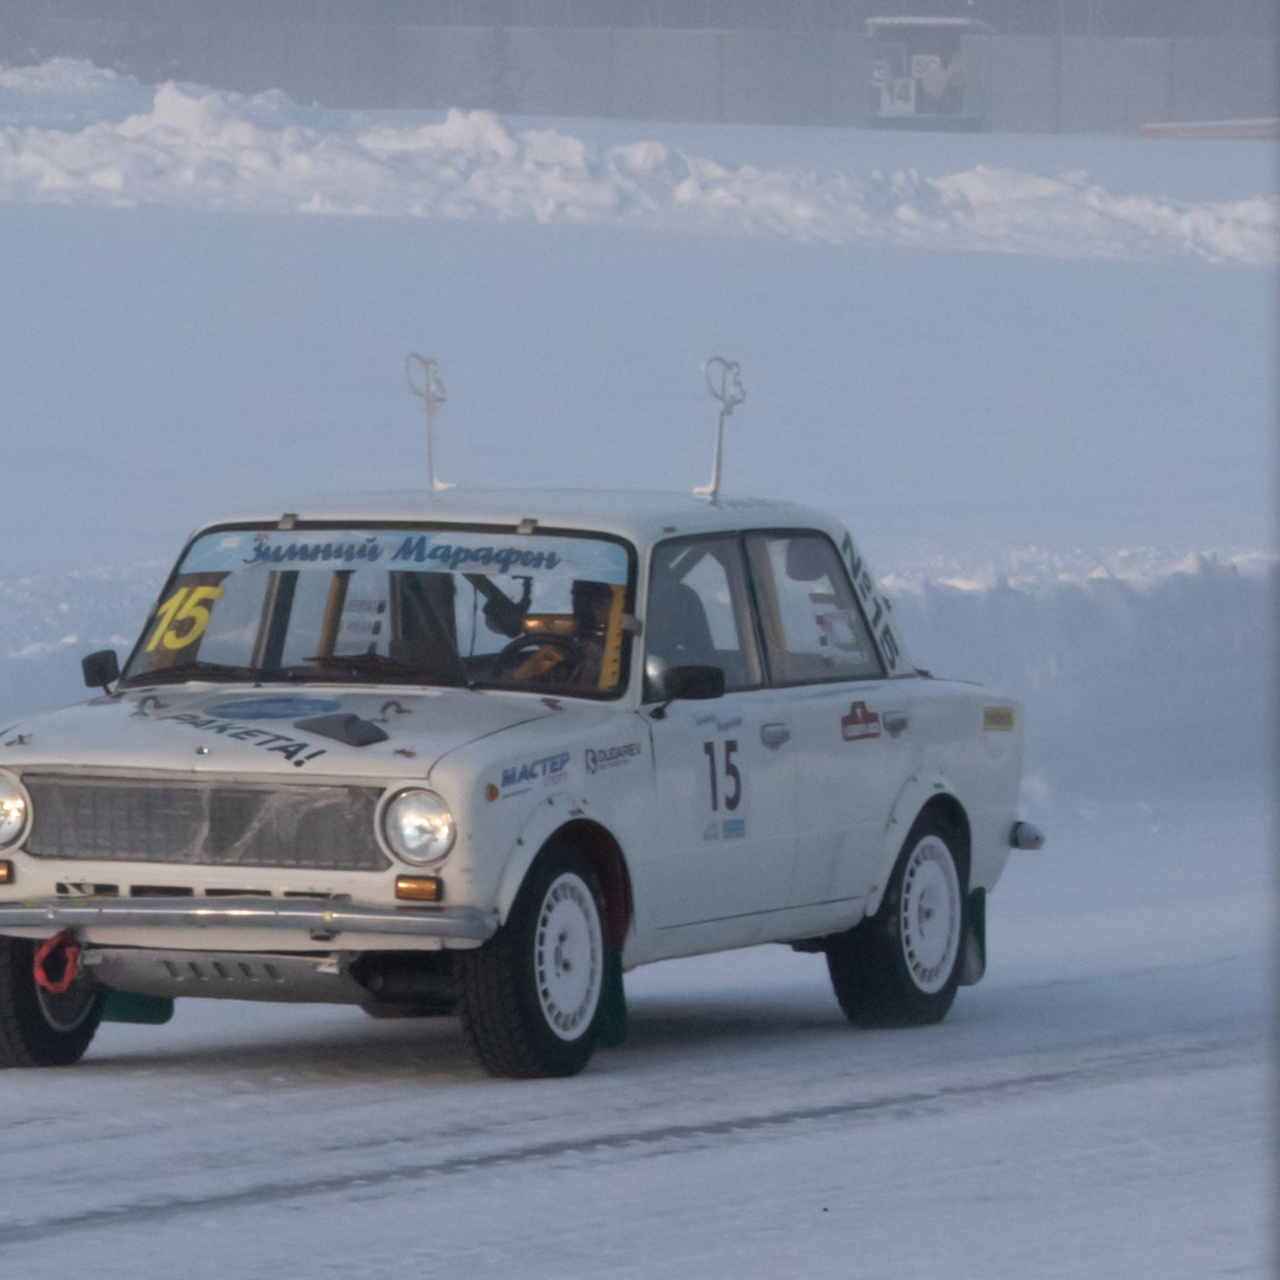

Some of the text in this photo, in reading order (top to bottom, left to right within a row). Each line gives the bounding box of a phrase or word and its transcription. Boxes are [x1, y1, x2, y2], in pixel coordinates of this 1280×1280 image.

[885, 80, 912, 105] 14
[243, 536, 562, 571] Зимний Марафон
[146, 586, 223, 653] 15
[157, 713, 327, 768] РАКЕТА!
[501, 751, 570, 787] МАСТЕР
[703, 739, 742, 811] 15
